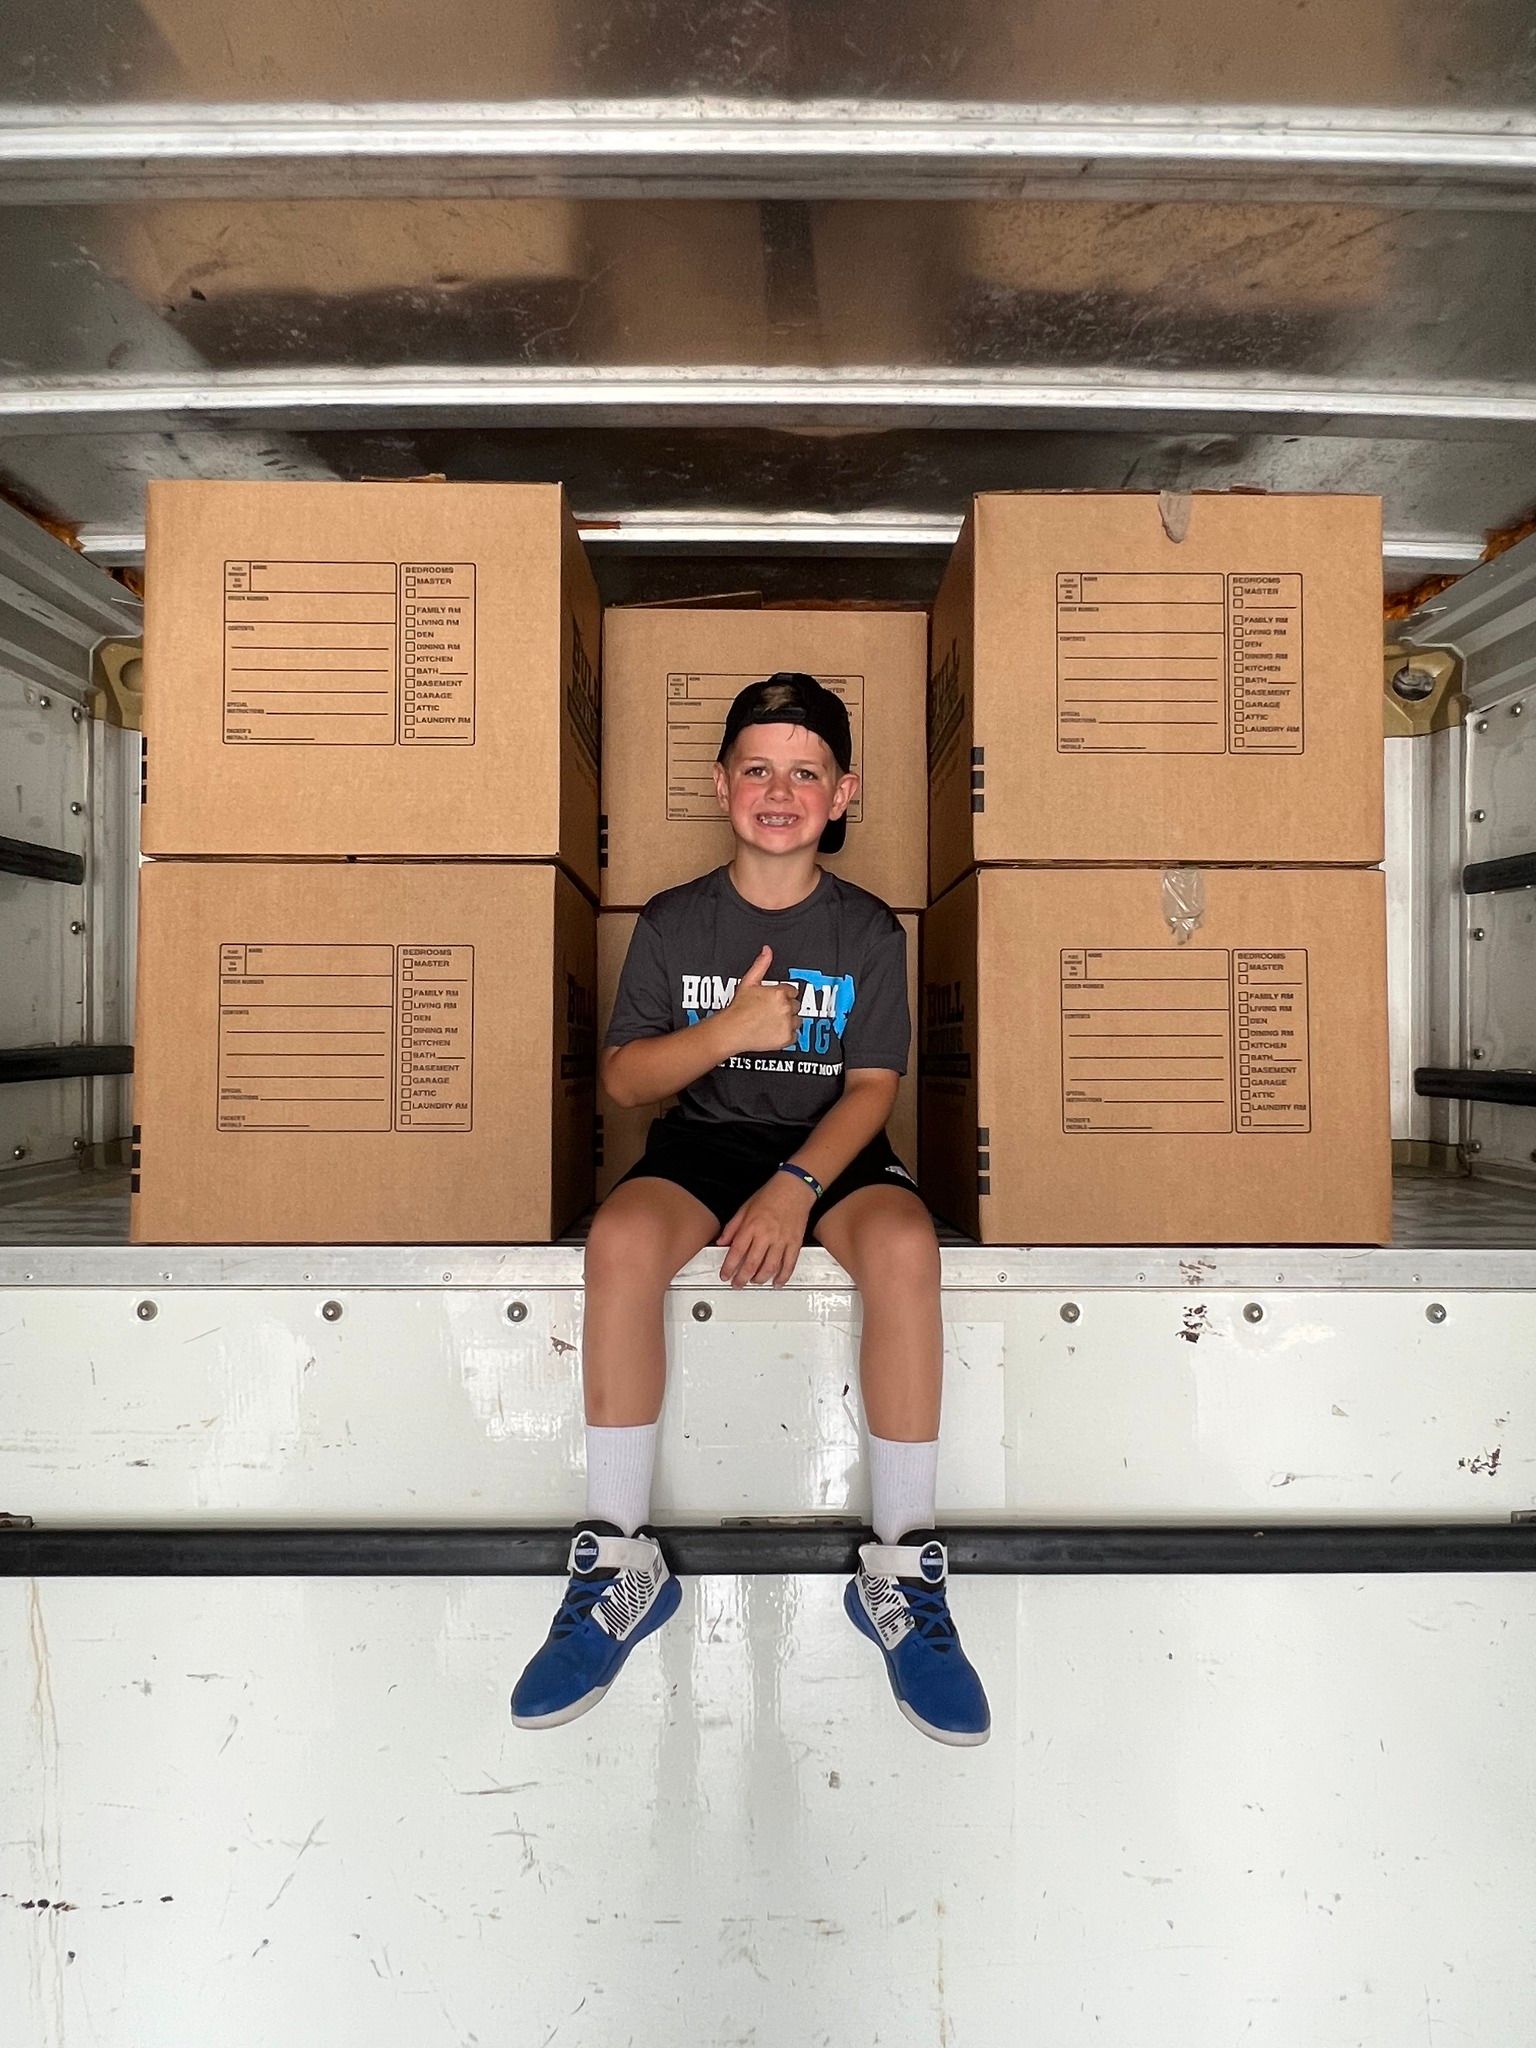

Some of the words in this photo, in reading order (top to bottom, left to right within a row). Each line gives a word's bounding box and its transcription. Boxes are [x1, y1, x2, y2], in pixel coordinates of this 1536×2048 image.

[682, 975, 742, 1010] HOM
[761, 980, 839, 1018] AM
[729, 1057, 751, 1070] FL'S
[754, 1059, 795, 1072] CLEAN
[797, 1061, 818, 1074] CUT
[413, 1102, 453, 1110] LAUNDRY
[455, 1102, 468, 1110] RM
